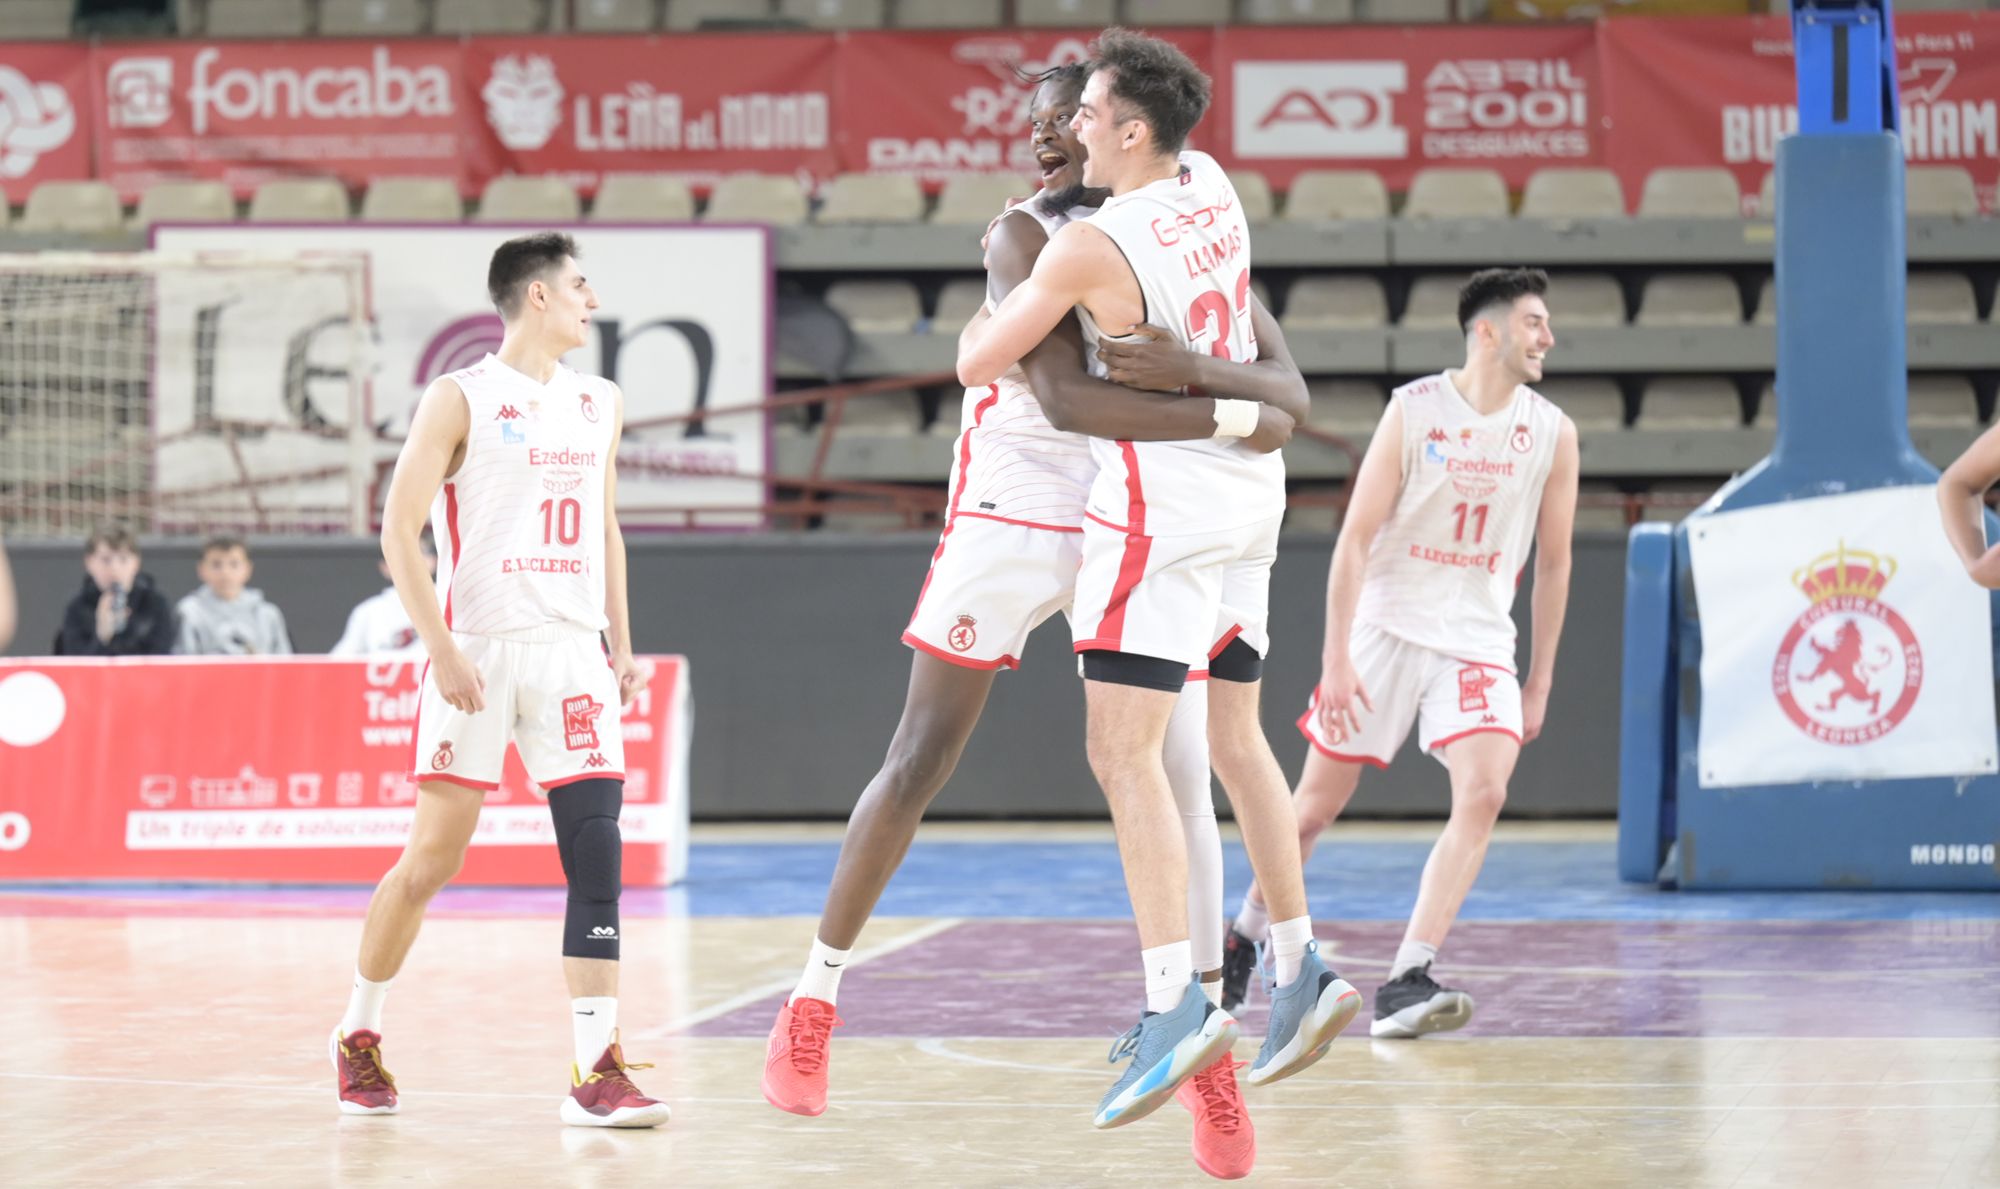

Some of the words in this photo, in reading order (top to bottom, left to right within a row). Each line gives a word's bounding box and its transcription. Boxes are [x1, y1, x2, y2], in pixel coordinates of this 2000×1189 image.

[1425, 59, 1586, 90] ABRIL
[189, 47, 455, 133] foncaba
[575, 82, 683, 150] LEÑA
[1424, 92, 1587, 129] 2001
[868, 139, 999, 166] DANI
[1423, 133, 1589, 157] DESGUACES
[1183, 224, 1242, 280] LLANAS
[529, 447, 597, 467] Ezedent
[1446, 458, 1514, 476] Ezedent
[539, 497, 581, 546] 10
[1452, 502, 1489, 544] 11
[1804, 718, 1893, 745] LEONESA
[138, 817, 171, 839] Un
[181, 817, 246, 845] triple
[258, 816, 284, 837] de
[1911, 845, 1995, 864] MONDO
